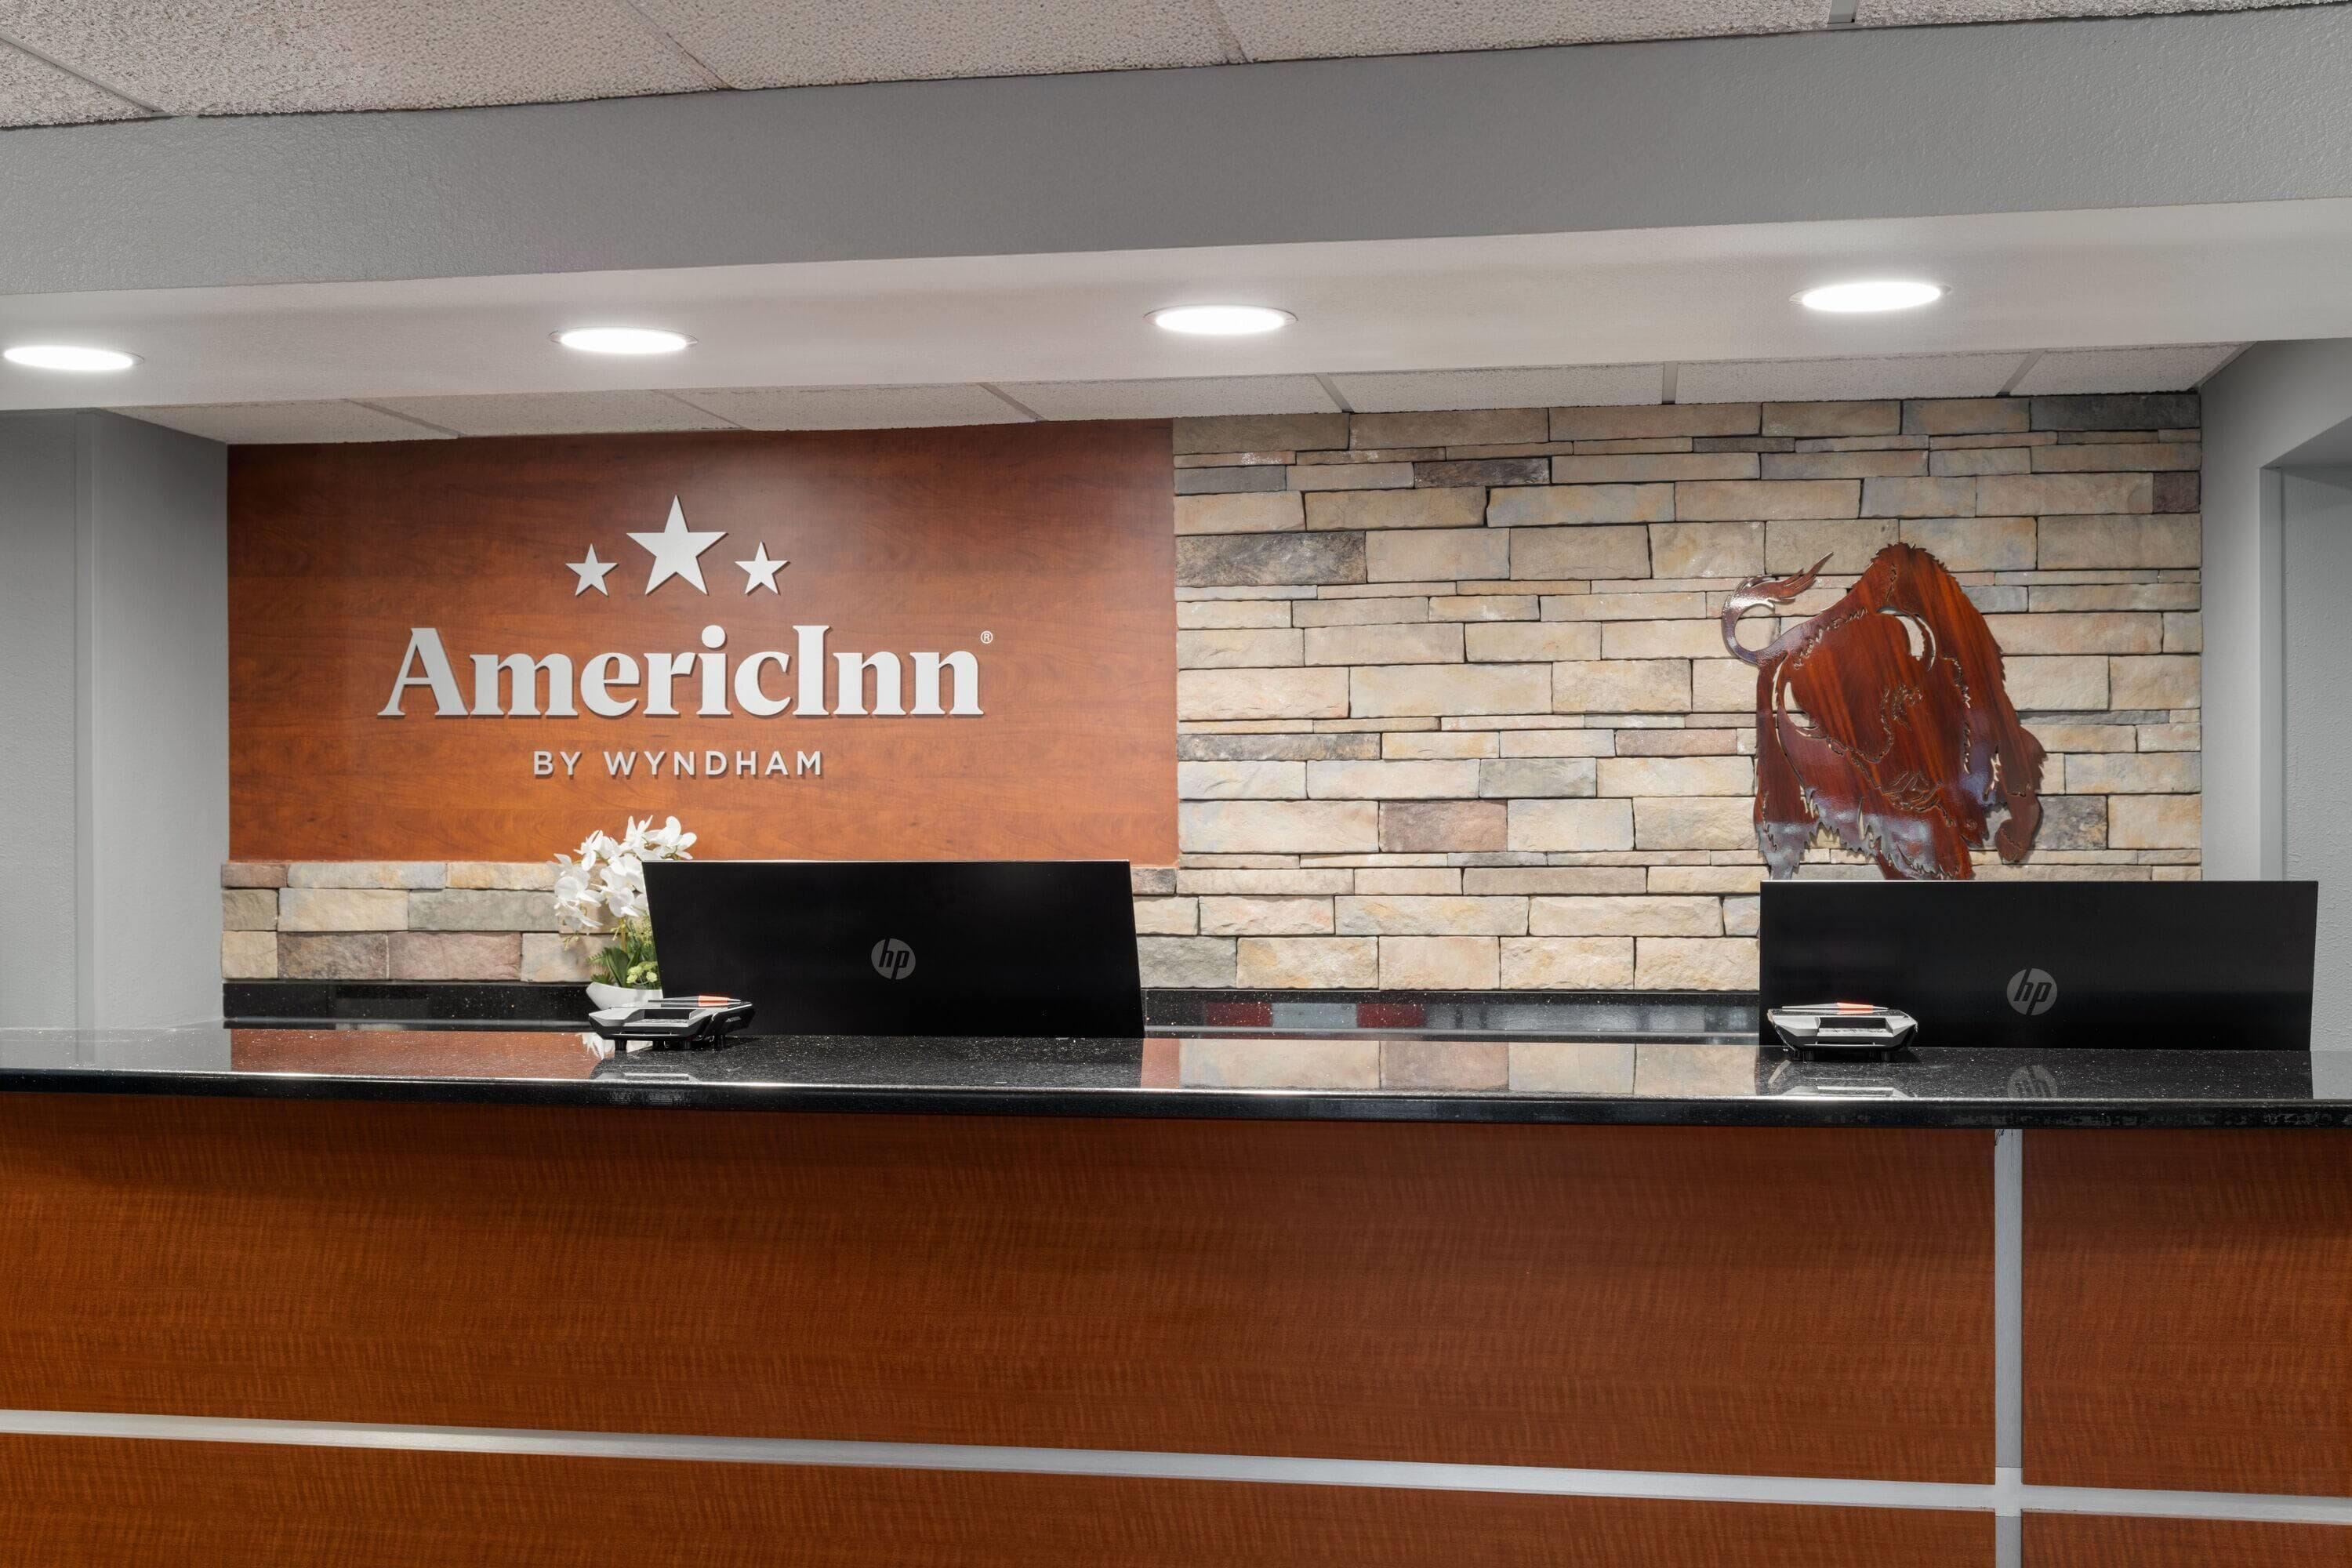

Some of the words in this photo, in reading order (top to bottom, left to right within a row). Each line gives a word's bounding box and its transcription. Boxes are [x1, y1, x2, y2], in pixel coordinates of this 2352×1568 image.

[534, 750, 580, 775] BY
[604, 750, 822, 775] WYNDHAM
[878, 938, 910, 980] hp
[2013, 967, 2053, 1015] hp
